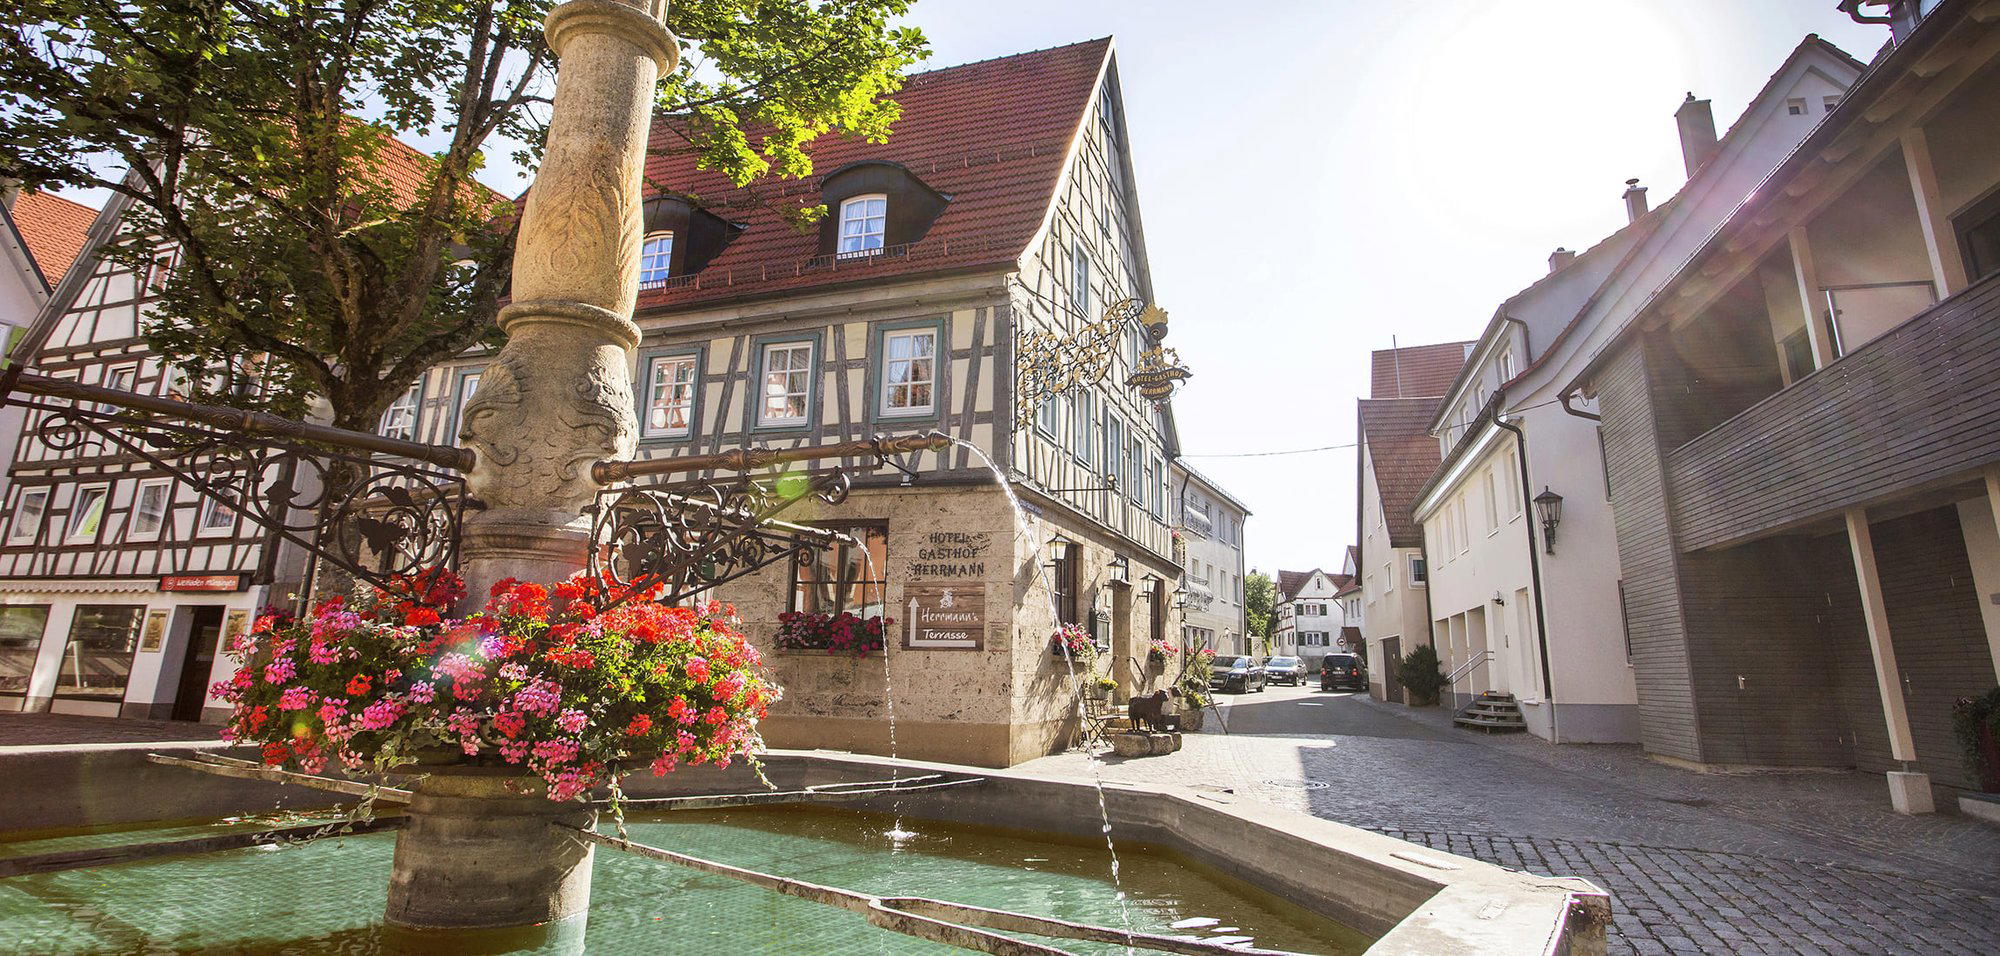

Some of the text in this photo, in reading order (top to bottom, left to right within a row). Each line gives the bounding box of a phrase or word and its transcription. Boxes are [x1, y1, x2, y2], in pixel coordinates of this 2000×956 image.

[1132, 370, 1184, 384] HOTEL-GASTHOF
[929, 532, 968, 544] HOTEL
[918, 547, 979, 560] GASTHOF
[913, 562, 984, 577] HERRMANN
[921, 607, 979, 622] Herrmann's
[923, 628, 968, 640] Terrasse
